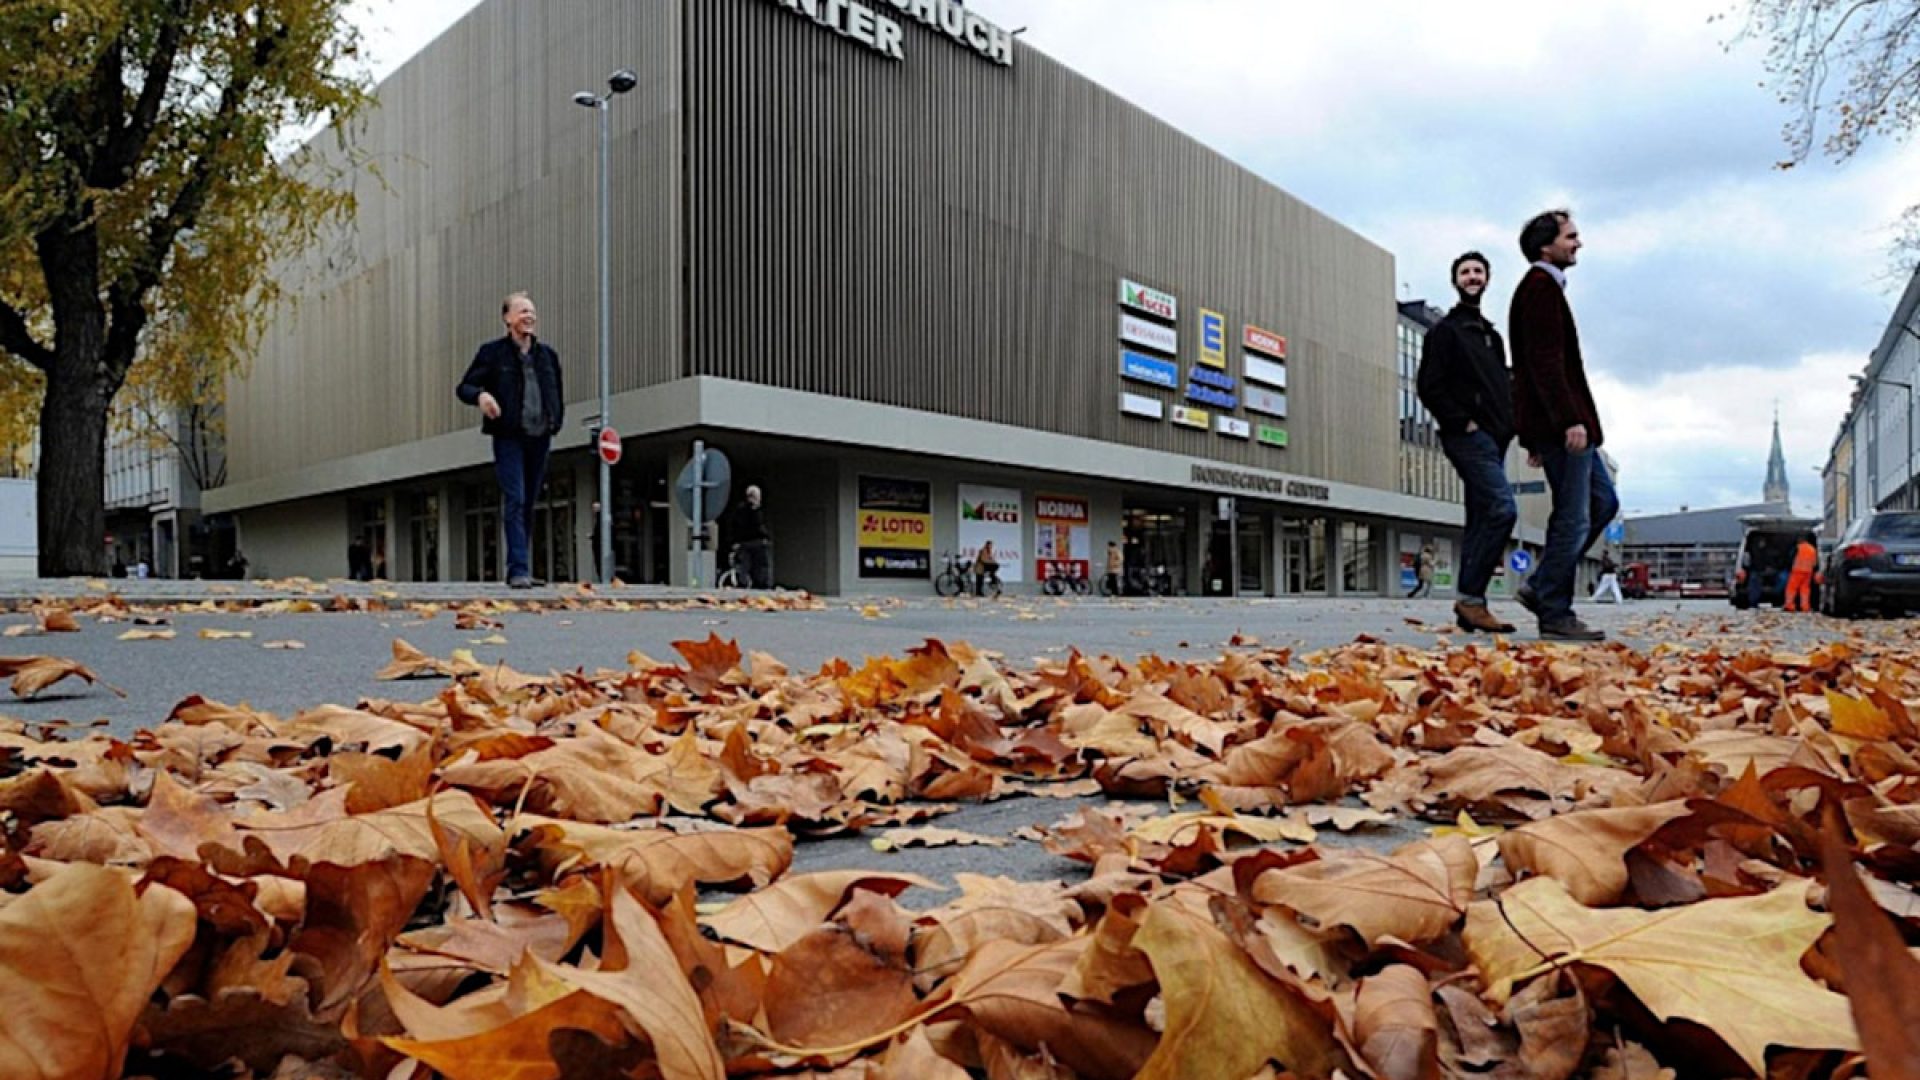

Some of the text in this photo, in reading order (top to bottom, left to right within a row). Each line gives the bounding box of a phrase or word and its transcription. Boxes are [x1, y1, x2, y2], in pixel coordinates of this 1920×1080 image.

[889, 0, 1013, 66] HUCH
[1038, 500, 1085, 518] NORMA
[882, 516, 925, 535] LOTTO
